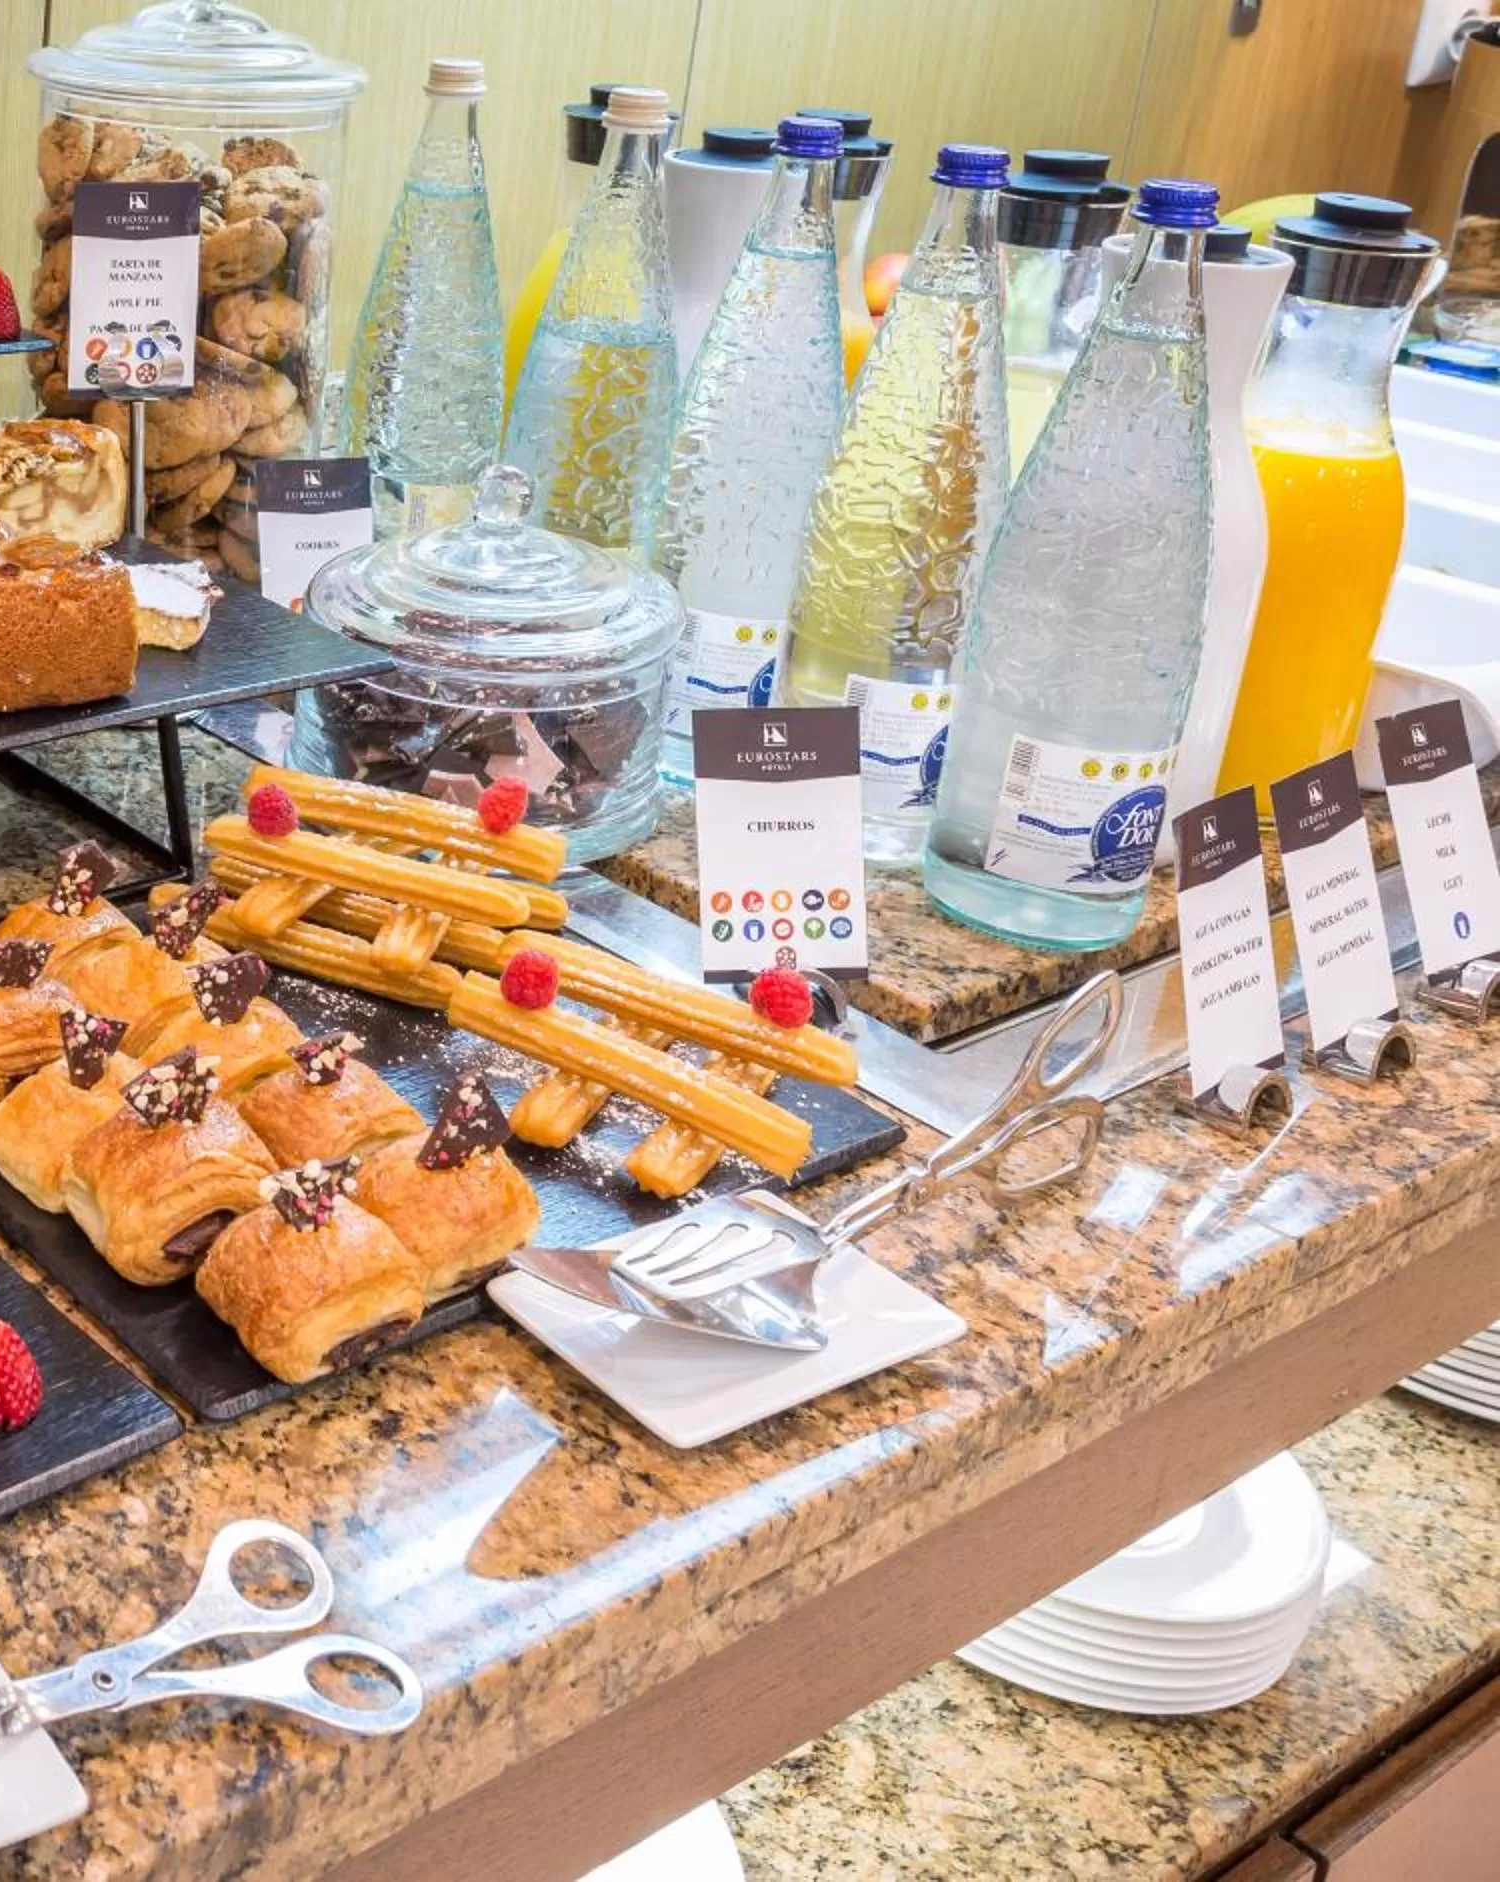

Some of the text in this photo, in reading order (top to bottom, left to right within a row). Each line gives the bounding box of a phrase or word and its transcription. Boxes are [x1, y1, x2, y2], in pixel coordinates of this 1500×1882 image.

[105, 214, 170, 225] EUROSTARS
[110, 259, 162, 269] TARTA DE
[109, 272, 163, 281] MANZANA
[107, 297, 163, 308] APPLE PIE
[295, 540, 340, 550] COOKIES
[736, 751, 818, 764] EUROSTARS
[747, 819, 816, 832] CHURROS
